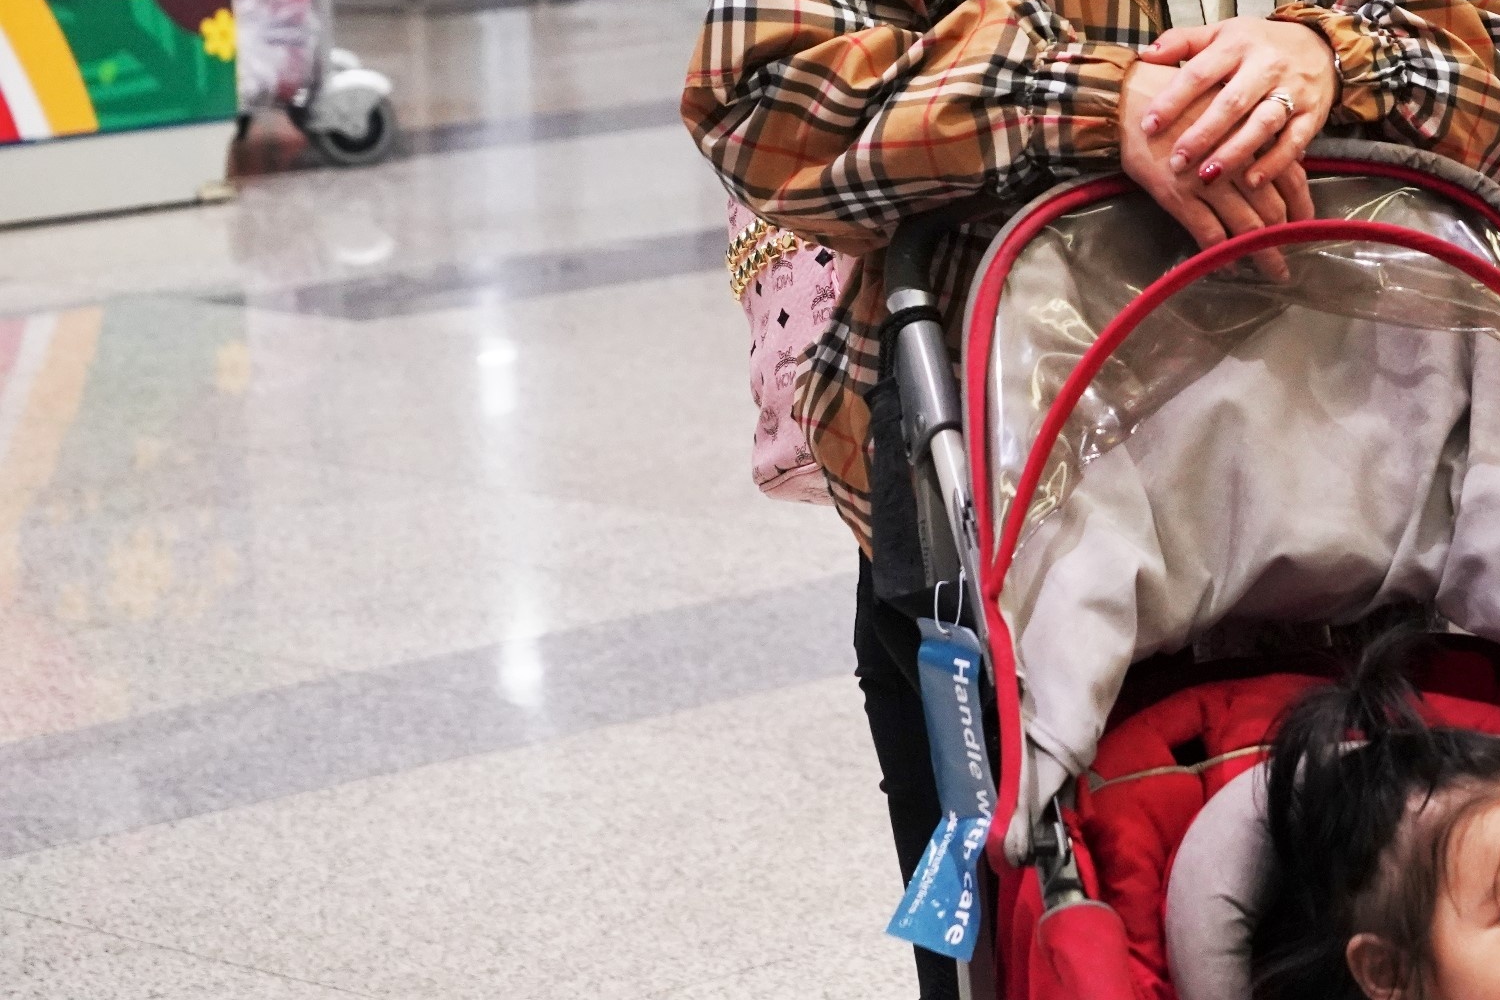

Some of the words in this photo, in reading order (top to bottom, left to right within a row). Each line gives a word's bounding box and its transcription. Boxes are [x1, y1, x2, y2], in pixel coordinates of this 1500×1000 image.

[953, 657, 983, 780] Handle
[963, 789, 991, 861] with
[944, 871, 973, 945] care
